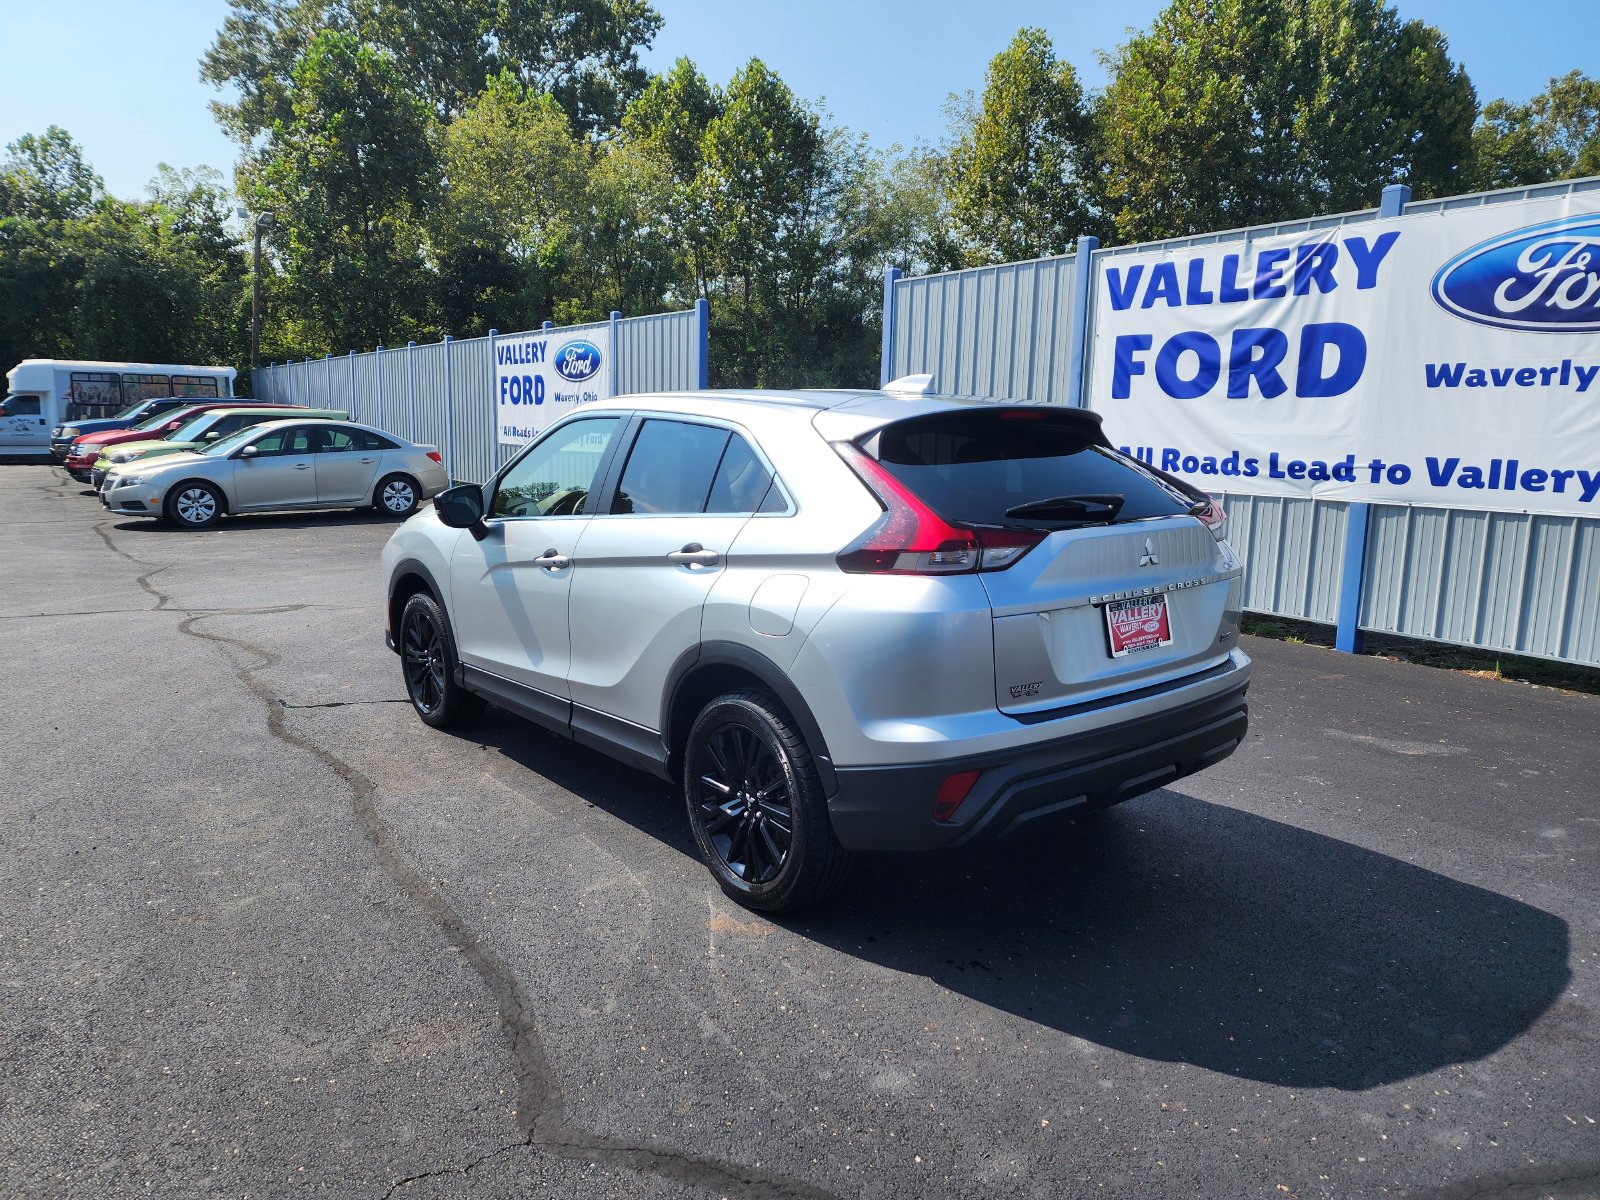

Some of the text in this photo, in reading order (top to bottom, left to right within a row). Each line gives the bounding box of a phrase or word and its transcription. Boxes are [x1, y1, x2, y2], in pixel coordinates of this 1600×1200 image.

[1105, 231, 1402, 311] VALLERY
[1493, 236, 1600, 313] Fo
[497, 340, 548, 366] VALLERY
[562, 347, 592, 374] Ford
[1111, 322, 1367, 400] FORD
[500, 374, 545, 405] FORD
[583, 391, 598, 401] Ohio
[512, 426, 531, 438] Roads
[1161, 447, 1259, 477] Roads
[1269, 451, 1357, 482] Lead
[1368, 458, 1411, 486] to
[1424, 456, 1600, 503] Vallery
[1089, 578, 1206, 604] ECLIPSE CROSS
[1121, 596, 1153, 610] VALLERY
[1110, 603, 1164, 624] VALLERY
[1010, 681, 1043, 693] VALLERY
